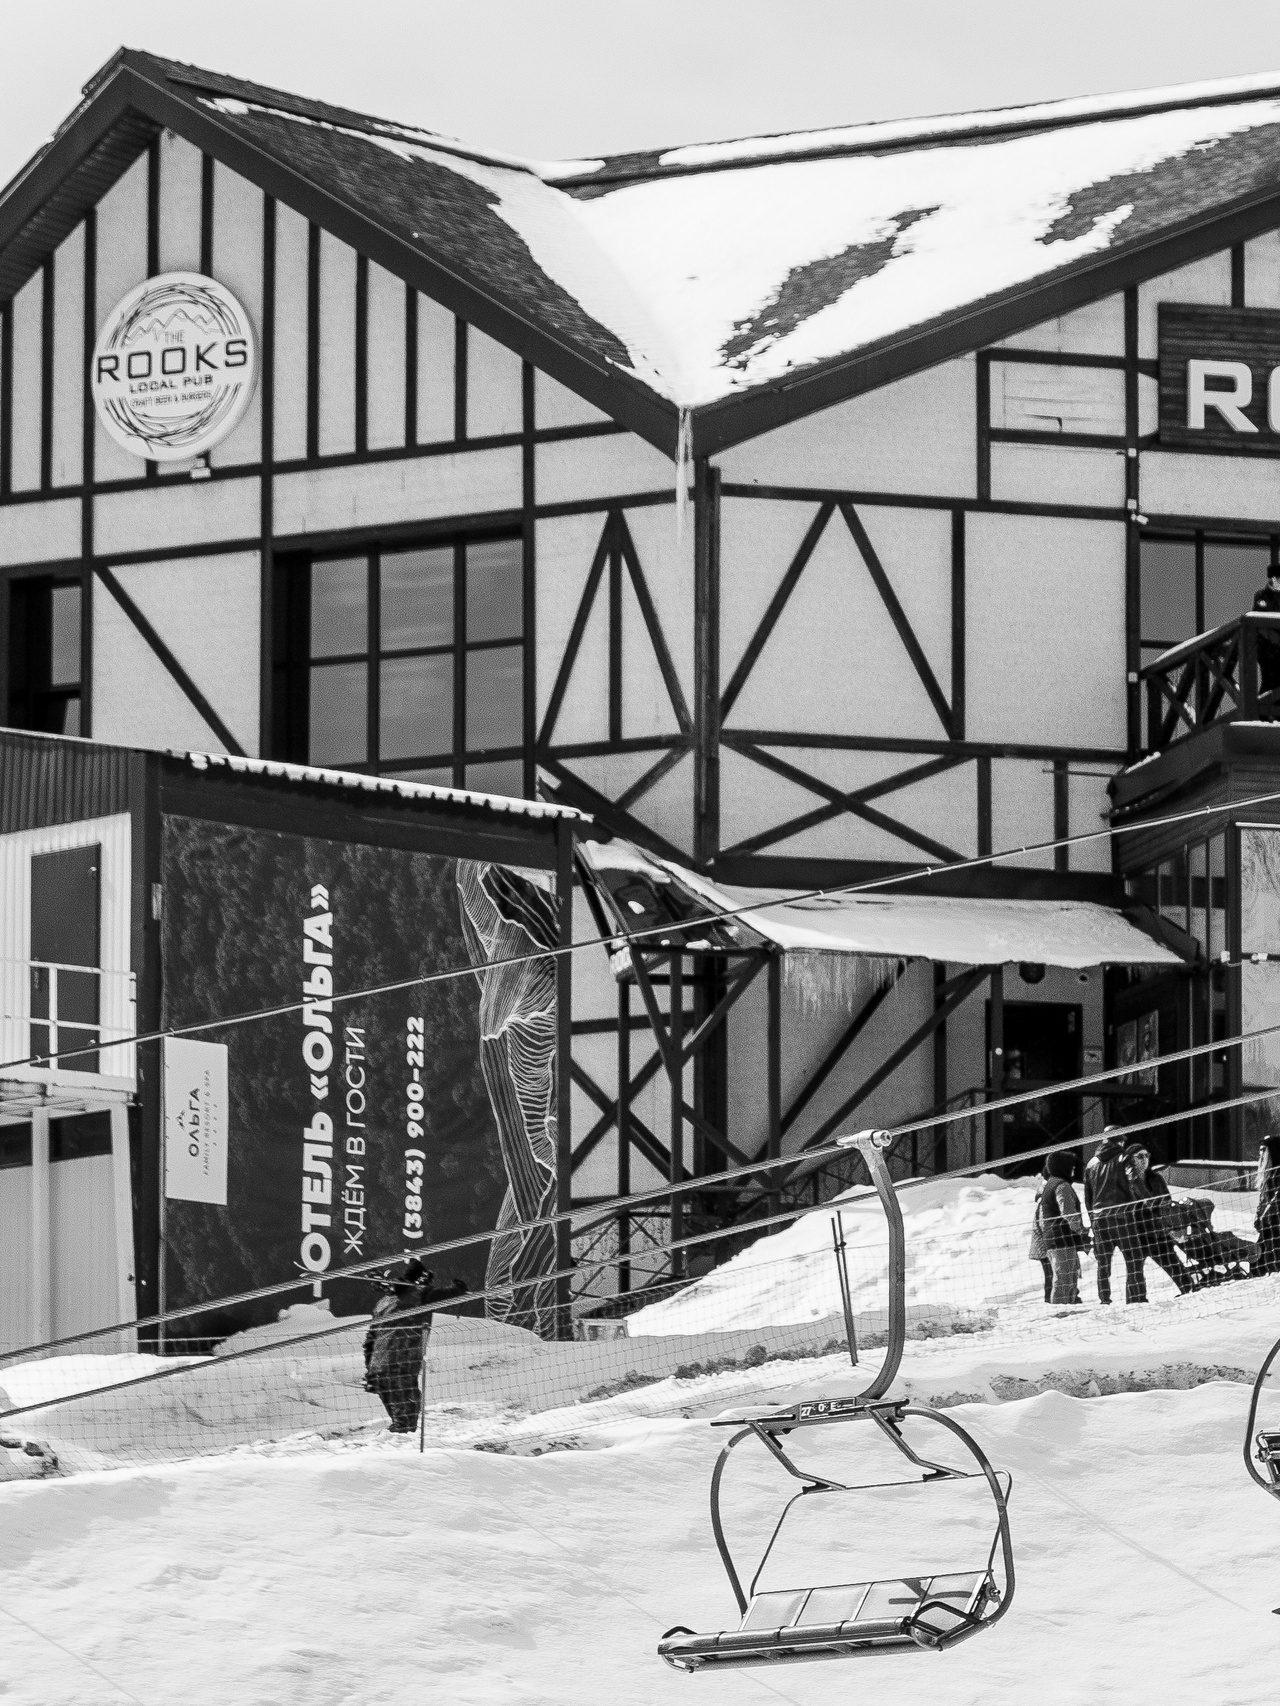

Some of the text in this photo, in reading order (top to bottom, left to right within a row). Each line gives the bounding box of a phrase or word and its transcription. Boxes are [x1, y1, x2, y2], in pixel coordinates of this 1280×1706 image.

[97, 339, 248, 384] ROOKS
[129, 374, 213, 394] LOCAL PUB
[302, 883, 333, 1100] «ОЛЬГА»
[406, 1016, 425, 1138] 900-222
[188, 1087, 200, 1157] ОЛЬГА
[341, 1026, 367, 1256] ЖДЁМ В ГОСТИ
[402, 1148, 426, 1239] (3843)
[801, 1406, 812, 1417] 27
